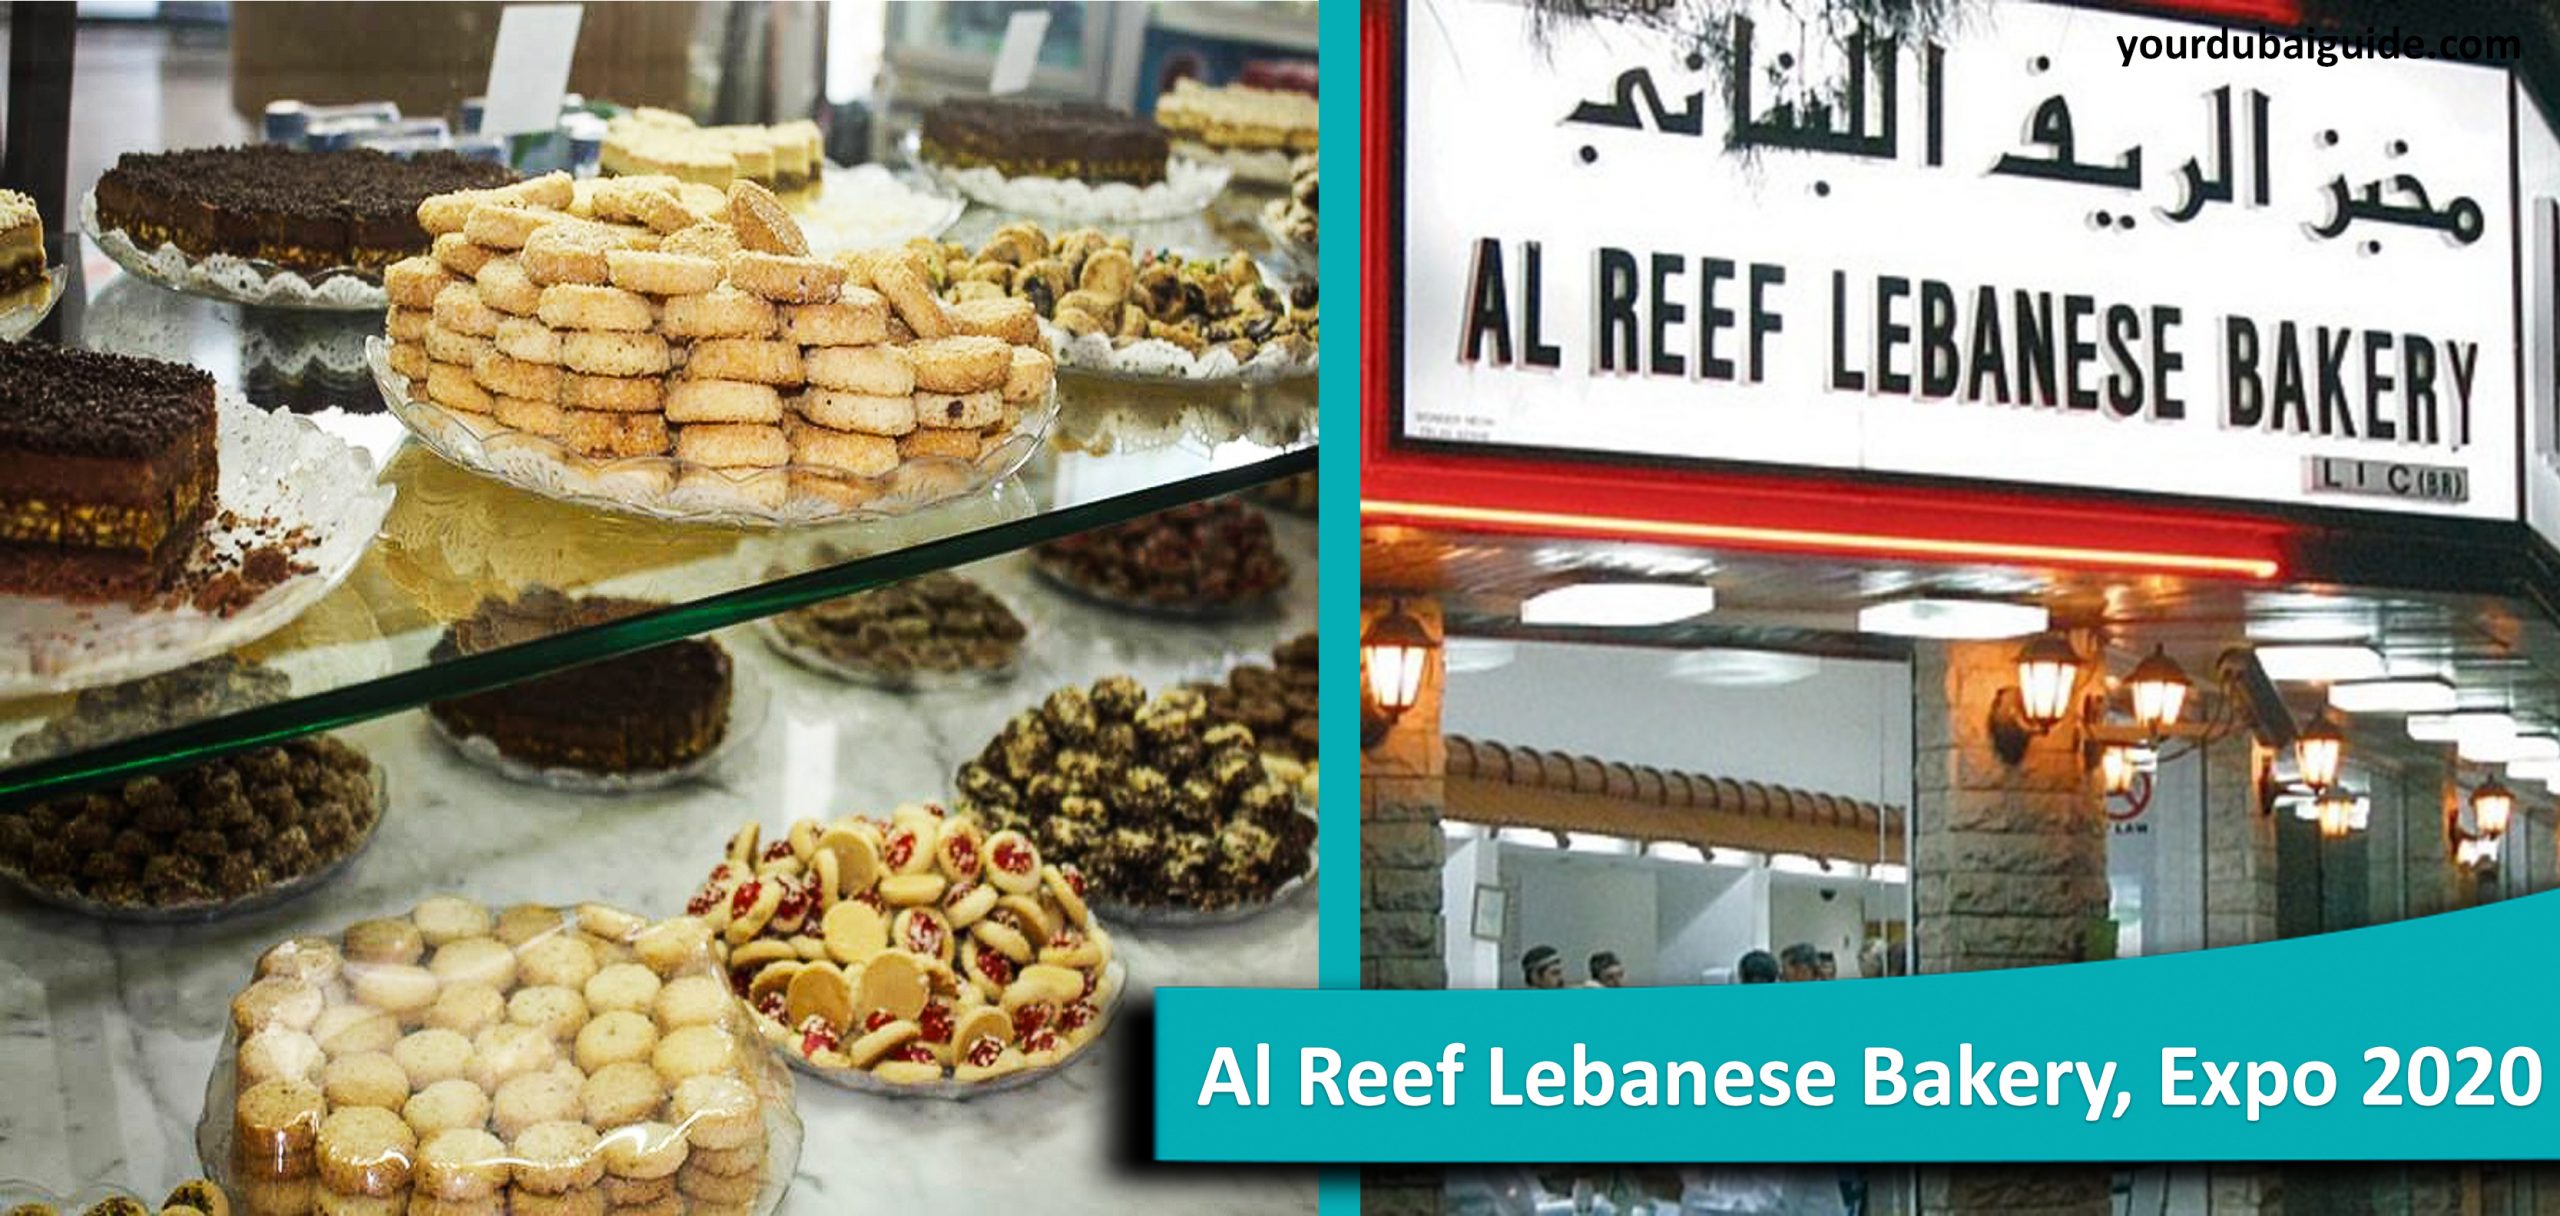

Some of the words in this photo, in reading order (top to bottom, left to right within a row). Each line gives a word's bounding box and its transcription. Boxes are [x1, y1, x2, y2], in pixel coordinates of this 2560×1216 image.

[1989, 55, 2271, 230] الريف
[2303, 129, 2484, 254] مخبز
[1460, 238, 1561, 368] AL
[1597, 247, 1786, 384] REEF
[1831, 270, 2186, 419] LEBANESE
[2226, 315, 2478, 446] BAKERY
